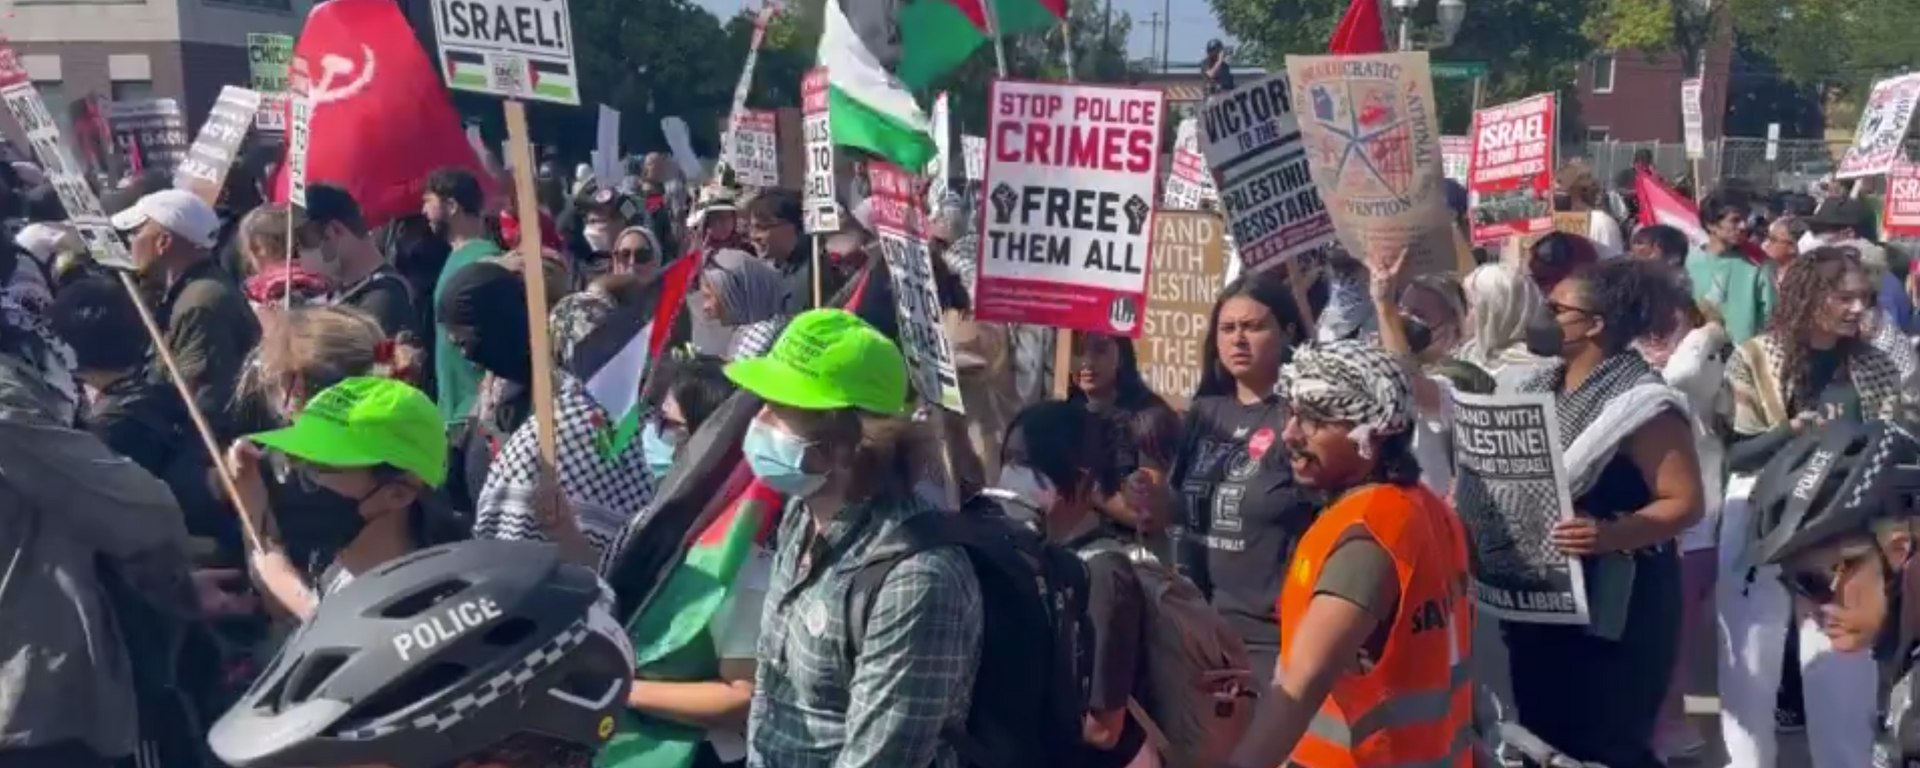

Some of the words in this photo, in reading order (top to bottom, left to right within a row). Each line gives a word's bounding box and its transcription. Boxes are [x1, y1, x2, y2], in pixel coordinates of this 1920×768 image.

[440, 1, 564, 48] ISRAEL!
[1000, 93, 1062, 118] STOP
[1074, 97, 1155, 125] POLICE
[1202, 75, 1292, 144] VICTOR
[996, 121, 1153, 173] CRIMES
[1237, 132, 1256, 151] TO
[1256, 121, 1280, 143] THE
[1477, 113, 1547, 151] ISRAEL
[813, 146, 830, 171] TO
[1020, 185, 1120, 232] FREE
[1153, 218, 1213, 245] TAND
[988, 231, 1071, 266] THEM
[1084, 239, 1141, 274] ALL
[1148, 273, 1220, 303] LESTINE
[1144, 308, 1207, 337] STOP
[1149, 337, 1199, 366] THE
[1147, 366, 1202, 396] NOCI
[1457, 405, 1489, 426] AND
[1494, 407, 1542, 427] WITH
[1792, 447, 1833, 500] POLICE
[1517, 591, 1572, 611] LIBRE
[393, 597, 502, 661] POLICE
